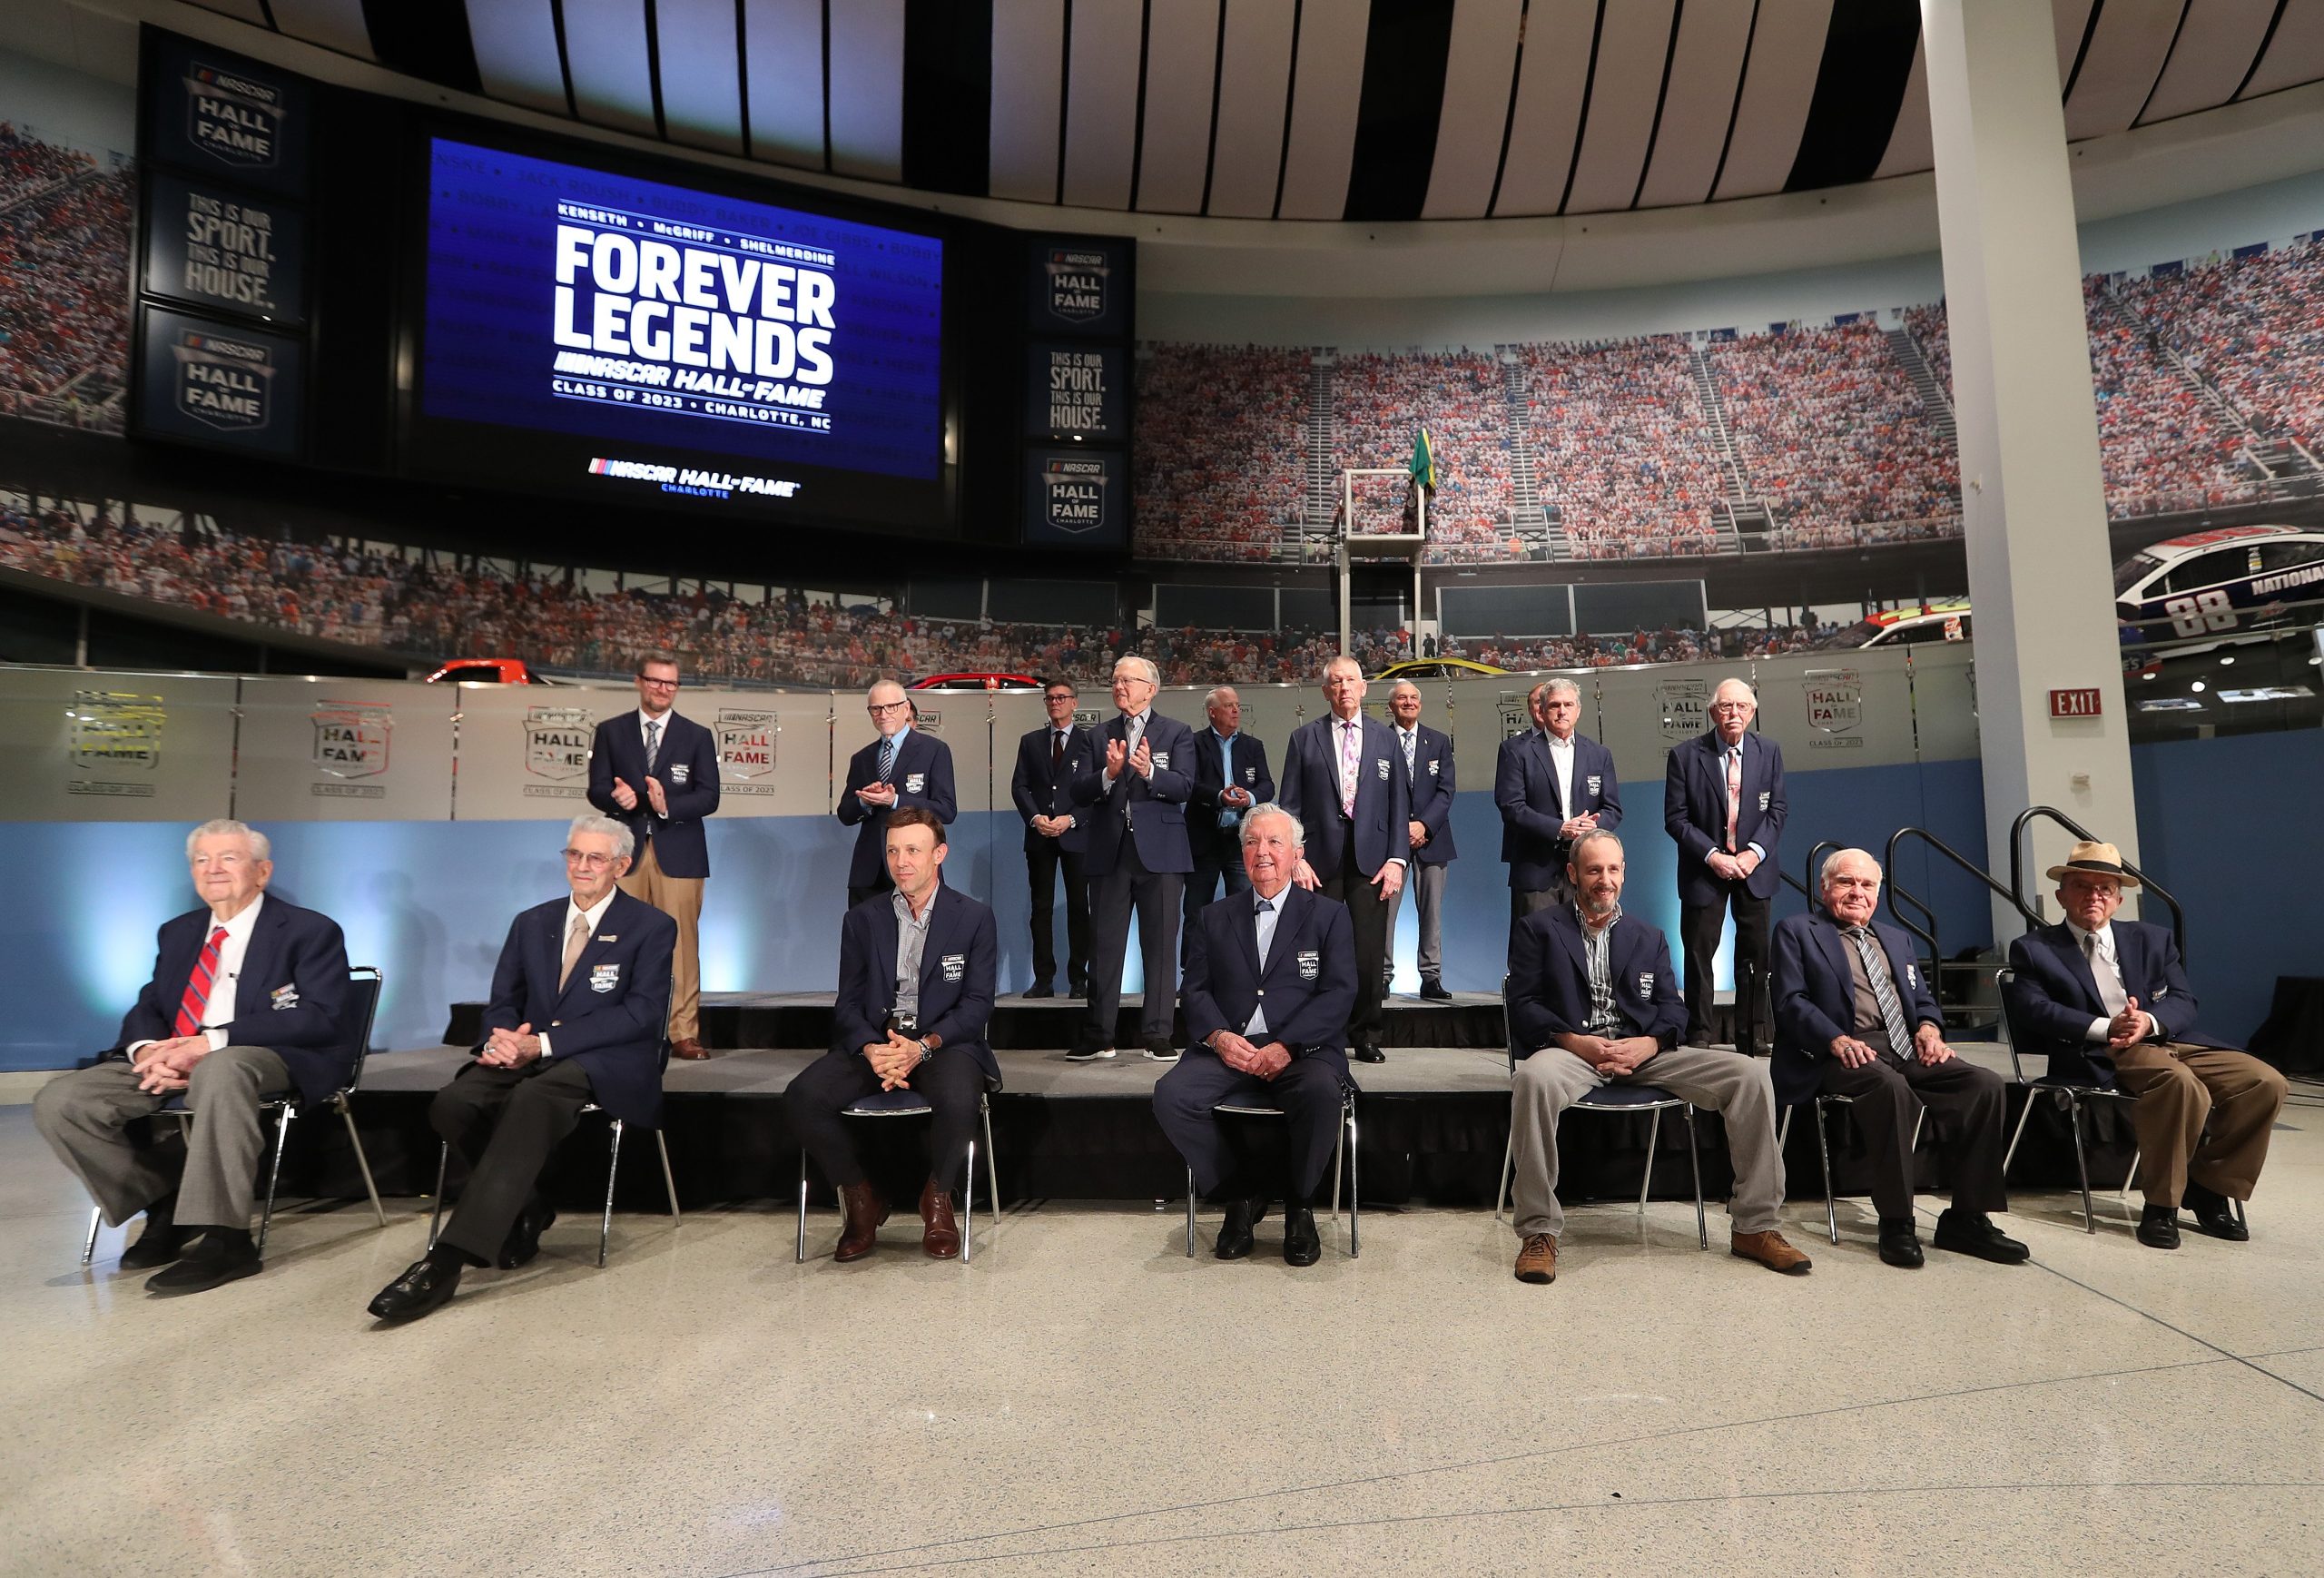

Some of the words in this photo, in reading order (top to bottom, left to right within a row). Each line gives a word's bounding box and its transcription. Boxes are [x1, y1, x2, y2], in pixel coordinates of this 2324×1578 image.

[217, 75, 274, 103] NASCAR
[199, 96, 271, 133] HALL
[198, 120, 271, 157] FAME
[189, 192, 222, 218] THIS
[224, 202, 240, 221] IS
[241, 207, 272, 231] OUR
[186, 211, 276, 262] SPORT.
[557, 204, 627, 226] KENSETH
[653, 222, 714, 242] McGRIFF
[740, 238, 835, 266] SHELMERDINE
[187, 242, 221, 266] THIS
[222, 252, 238, 271] IS
[239, 255, 270, 279] OUR
[1065, 254, 1102, 265] NASCAR
[184, 260, 276, 310] HOUSE.
[556, 225, 836, 330] FOREVER
[1055, 274, 1100, 290] HALL
[1054, 293, 1100, 309] FAME
[554, 286, 833, 385] LEGENDS
[205, 339, 265, 362] NASCAR
[1050, 351, 1070, 365] THIS
[1073, 353, 1082, 366] IS
[1084, 354, 1102, 368] OUR
[187, 363, 261, 393] HALL
[579, 355, 672, 387] NASCAR
[674, 370, 744, 399] HALL
[753, 381, 827, 409] FAME
[1050, 366, 1106, 392] SPORT.
[186, 387, 261, 418] FAME
[552, 380, 607, 399] CLASS
[614, 388, 635, 400] OF
[641, 392, 683, 409] 2023
[704, 401, 804, 427] CHARLOTTE,
[811, 416, 832, 429] NC
[1050, 390, 1070, 404] THIS
[1073, 391, 1081, 405] IS
[1084, 392, 1102, 406] OUR
[1050, 405, 1107, 430] HOUSE.
[609, 460, 677, 484] NASCAR
[679, 469, 734, 490] HALL
[739, 477, 795, 498] FAME
[1063, 462, 1100, 473] NASCAR
[661, 483, 729, 499] CHARLOTTE
[1053, 484, 1098, 499] HALL
[1052, 503, 1098, 518] FAME
[2251, 566, 2324, 597] NATIONA
[2165, 589, 2240, 638] 88
[1813, 692, 1854, 704] HALL
[2057, 691, 2095, 715] EXIT
[736, 714, 773, 723] NASCAR
[916, 713, 937, 723] SCAR
[1814, 708, 1856, 720] FAME
[534, 733, 584, 747] HALL
[724, 733, 770, 747] HALL
[724, 751, 770, 764] FAME
